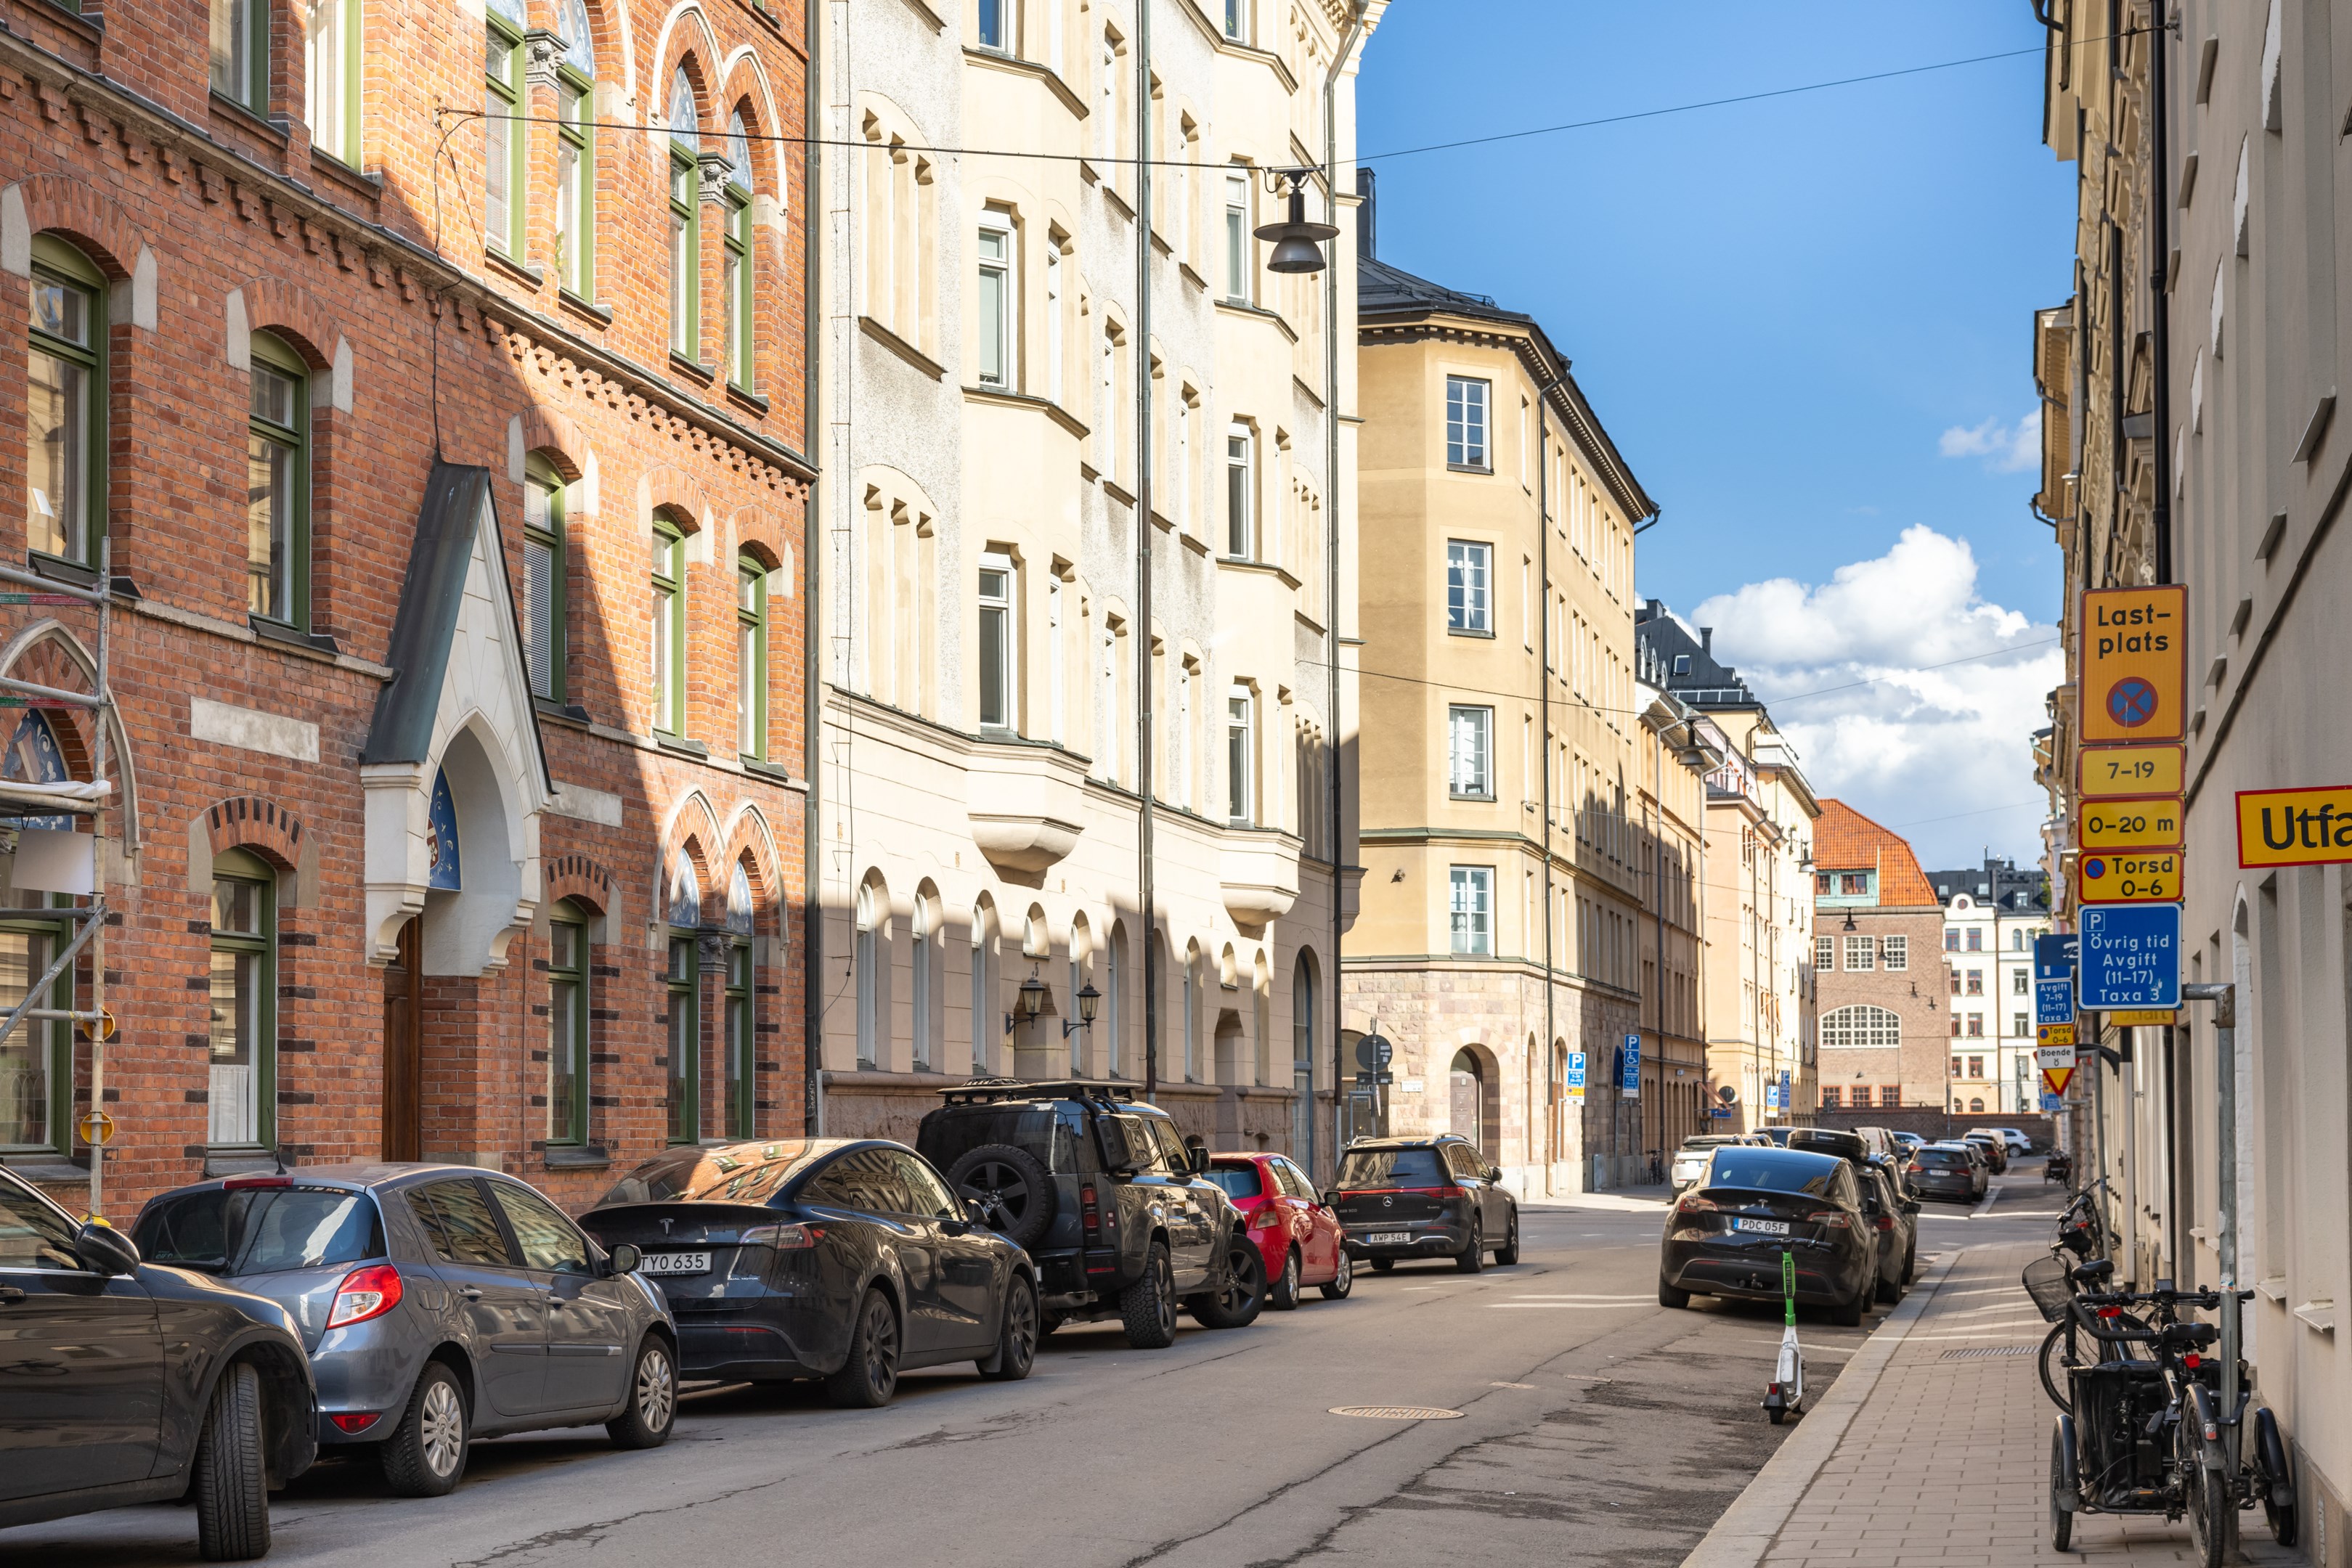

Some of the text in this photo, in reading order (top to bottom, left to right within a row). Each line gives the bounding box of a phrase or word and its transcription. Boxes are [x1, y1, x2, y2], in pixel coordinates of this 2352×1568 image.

[2098, 603, 2171, 626] Last-
[2099, 631, 2169, 659] plats
[2107, 761, 2154, 779] 7-19
[2089, 816, 2173, 833] 0-20 m
[2112, 856, 2173, 874] Torsd
[2121, 879, 2162, 897] 0-6
[2091, 914, 2101, 929] P
[2091, 933, 2139, 952] Övrig
[2146, 934, 2169, 948] tid
[2103, 952, 2157, 969] Avgift
[2106, 969, 2154, 986] (11-17)
[2040, 984, 2067, 993] Avgift
[2099, 988, 2160, 1002] Taxa 3
[2042, 1003, 2067, 1012] (11-17)
[1629, 1036, 1637, 1049] P
[2040, 1048, 2071, 1057] Boende
[1572, 1054, 1582, 1069] P
[1742, 1220, 1785, 1232] PDC 05F
[641, 1254, 704, 1270] TYO 635
